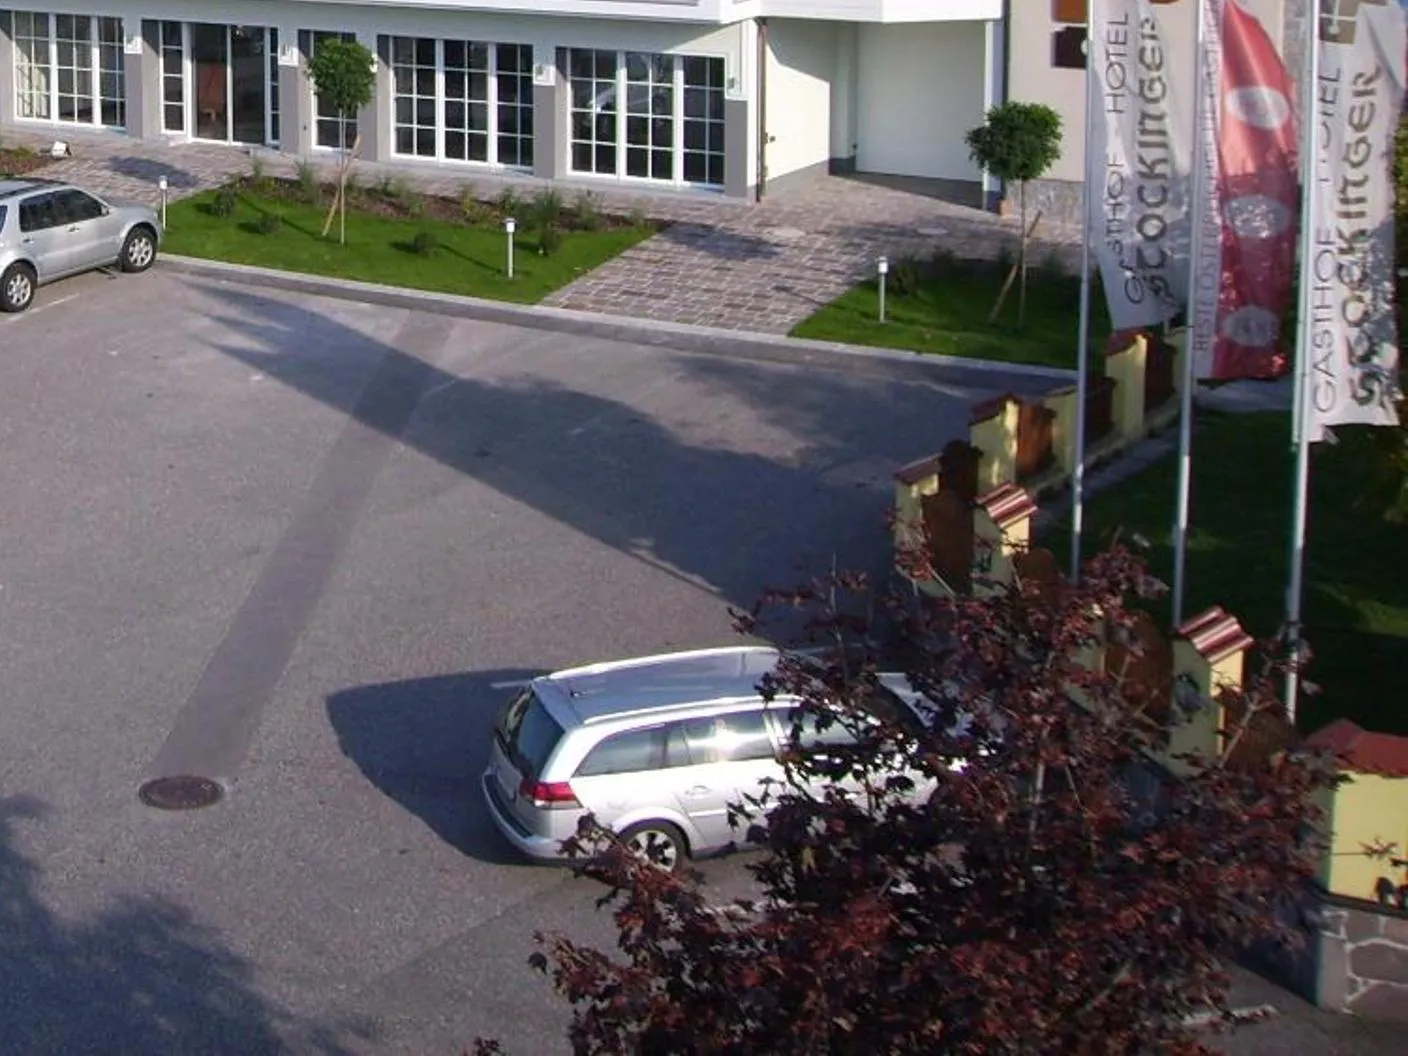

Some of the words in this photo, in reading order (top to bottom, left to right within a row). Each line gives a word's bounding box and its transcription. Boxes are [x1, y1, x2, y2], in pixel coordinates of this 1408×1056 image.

[1104, 11, 1130, 115] HOTEL
[1135, 15, 1175, 301] STOCKINGER
[1311, 227, 1337, 414] GASTHOF
[1336, 63, 1385, 409] STOCKINGER
